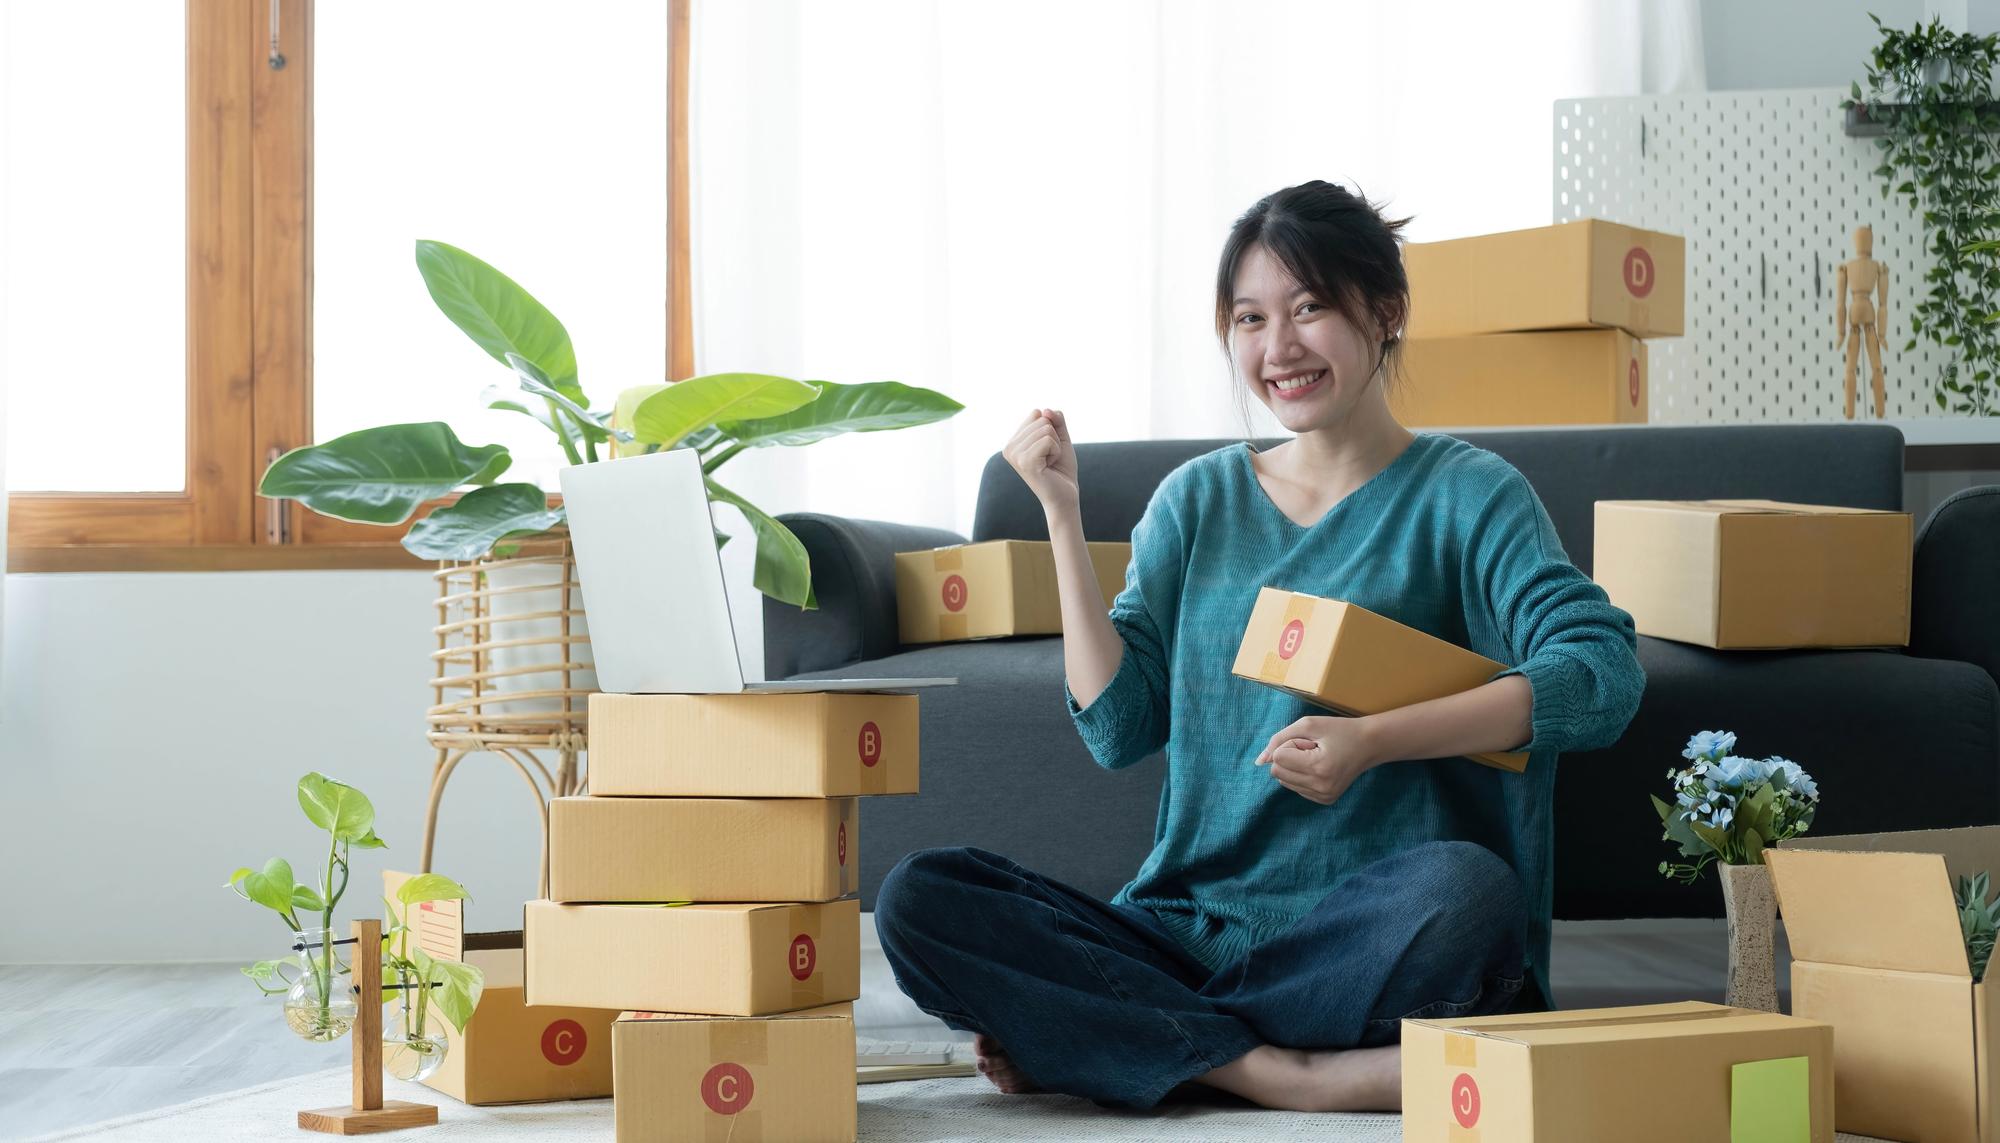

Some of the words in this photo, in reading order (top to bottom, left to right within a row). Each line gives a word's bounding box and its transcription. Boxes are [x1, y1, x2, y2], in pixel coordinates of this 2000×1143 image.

[1632, 258, 1647, 287] D
[949, 583, 961, 603] C
[1284, 629, 1299, 652] B
[864, 731, 876, 756] B
[840, 832, 845, 855] B
[796, 944, 809, 970] B
[556, 1030, 573, 1055] C
[718, 1075, 738, 1102] C
[1460, 1086, 1472, 1115] C
